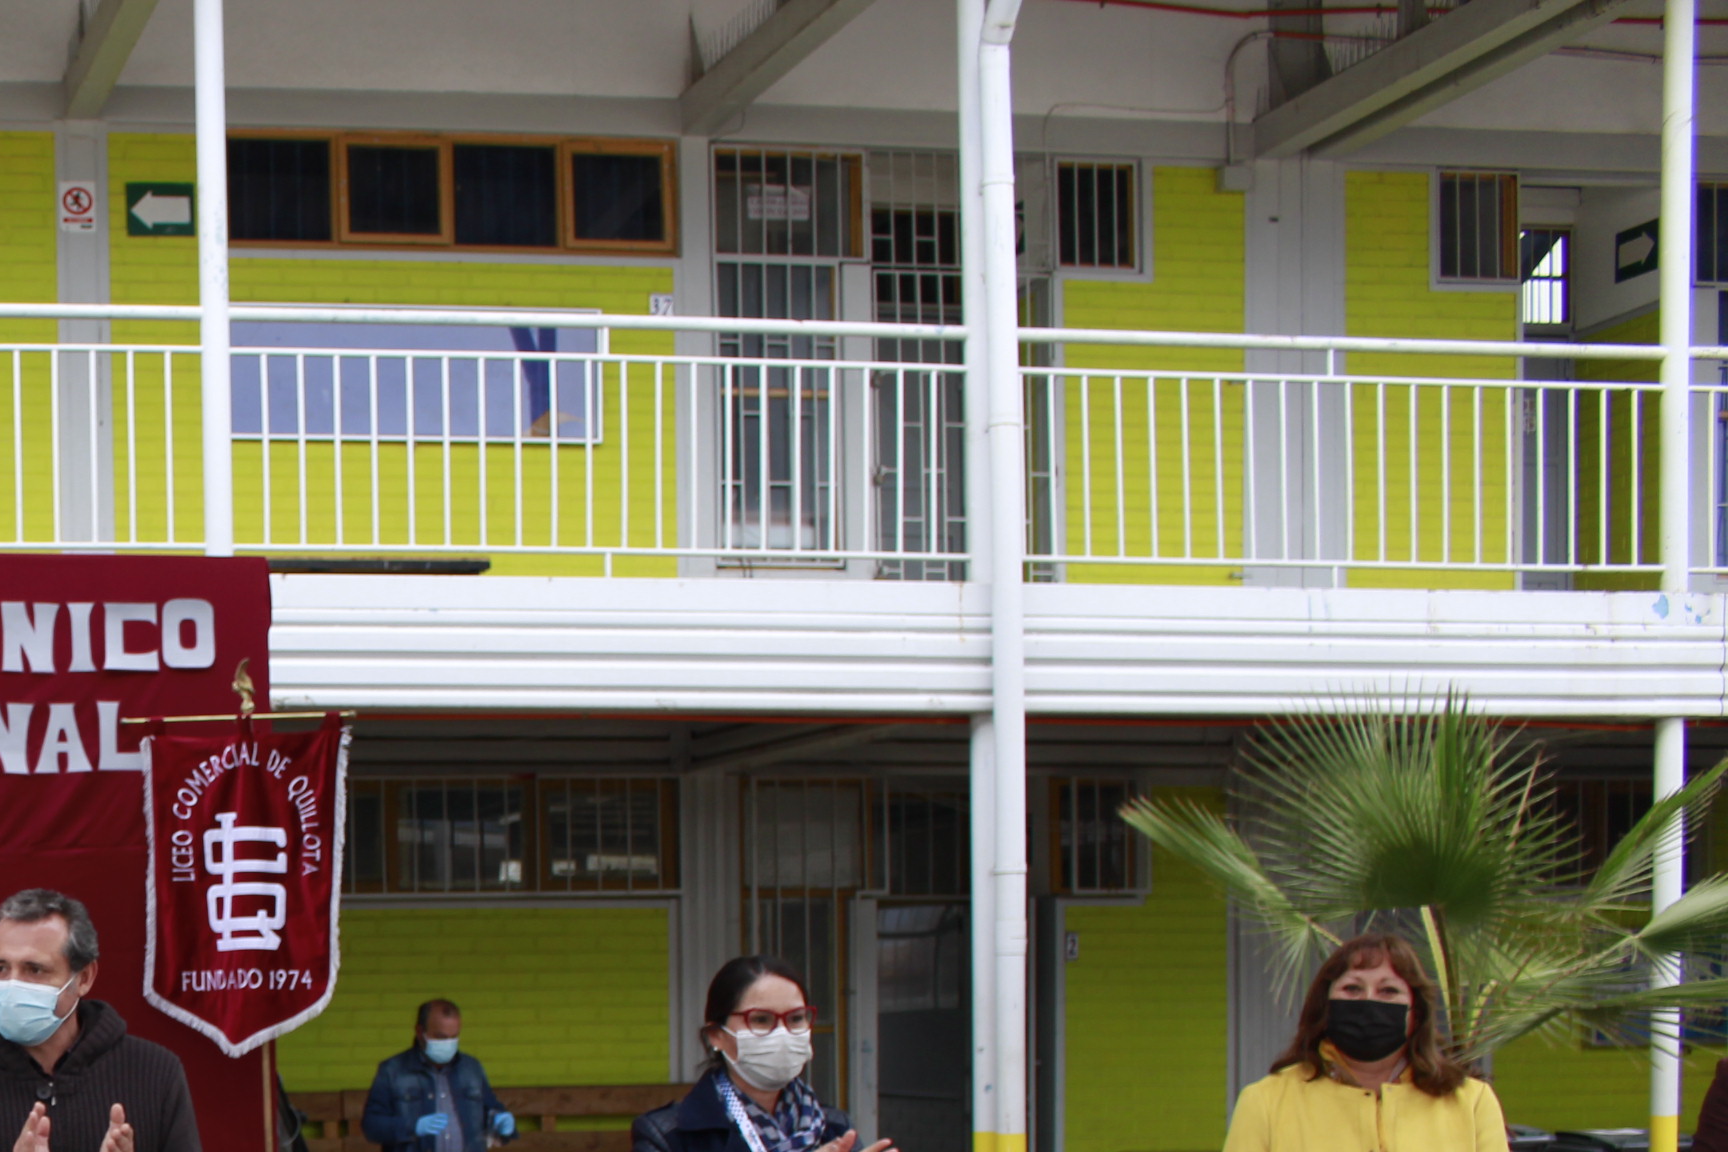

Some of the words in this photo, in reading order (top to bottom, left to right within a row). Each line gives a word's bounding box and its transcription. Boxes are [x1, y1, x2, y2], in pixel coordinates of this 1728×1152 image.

[172, 741, 260, 821] COMERCIAL
[266, 748, 292, 780] DE
[287, 775, 322, 877] QUILLOTA
[172, 830, 196, 883] LICEO
[181, 967, 264, 993] FUNDADO
[269, 968, 313, 991] 1974
